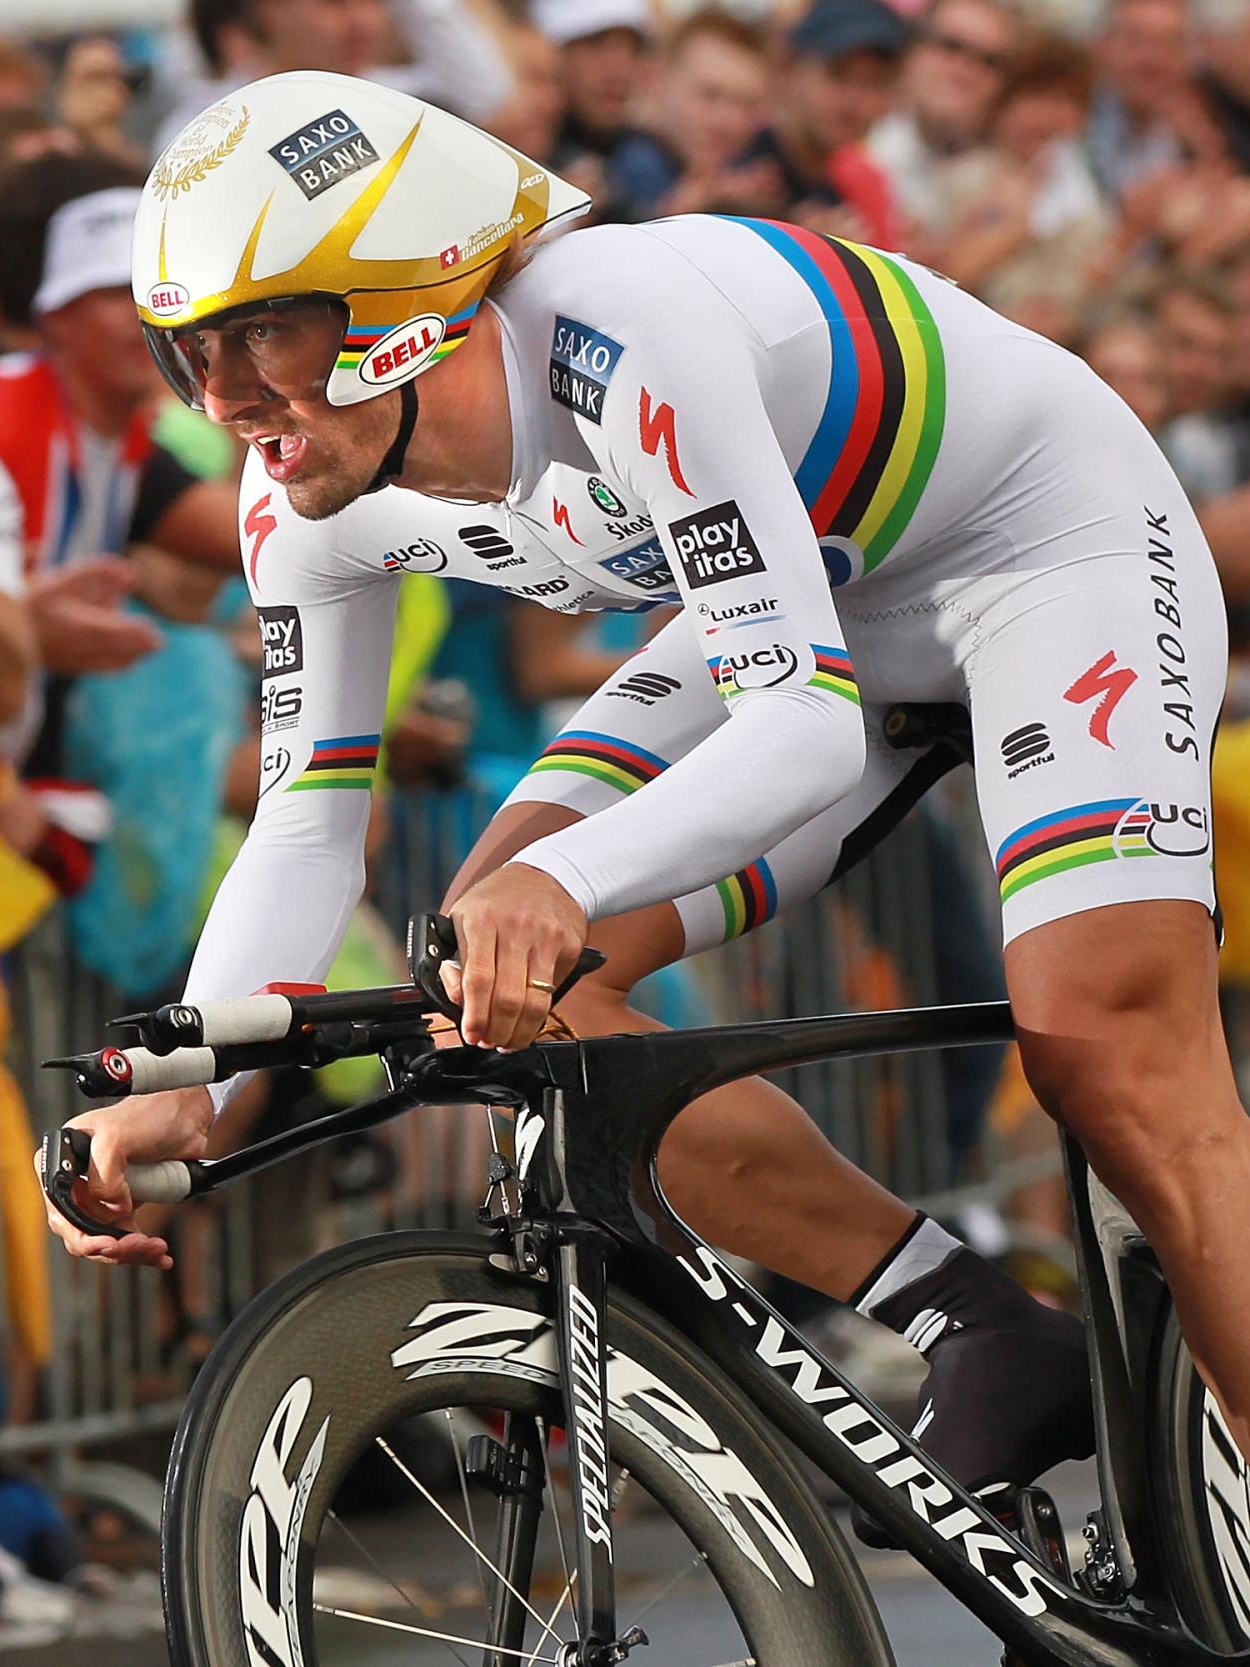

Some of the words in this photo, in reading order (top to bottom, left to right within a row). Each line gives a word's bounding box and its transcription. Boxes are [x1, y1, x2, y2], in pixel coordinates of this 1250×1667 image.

[279, 115, 350, 165] SAXO
[300, 137, 372, 190] BANK
[151, 289, 184, 309] BELL
[371, 325, 436, 379] BELL
[555, 327, 610, 373] SAXO
[552, 368, 600, 415] BANK
[604, 514, 654, 541] Škod
[676, 518, 739, 563] play
[486, 556, 528, 571] sportful
[611, 545, 663, 575] SAX
[694, 547, 753, 578] itas
[635, 570, 671, 586] BA
[711, 598, 778, 622] Luxair
[259, 615, 296, 649] lay
[263, 748, 282, 771] ci
[1007, 753, 1055, 779] sportful
[431, 1360, 547, 1380] SPEED
[569, 1284, 613, 1564] SPECIALIZED
[676, 1246, 1067, 1617] S-WORKS
